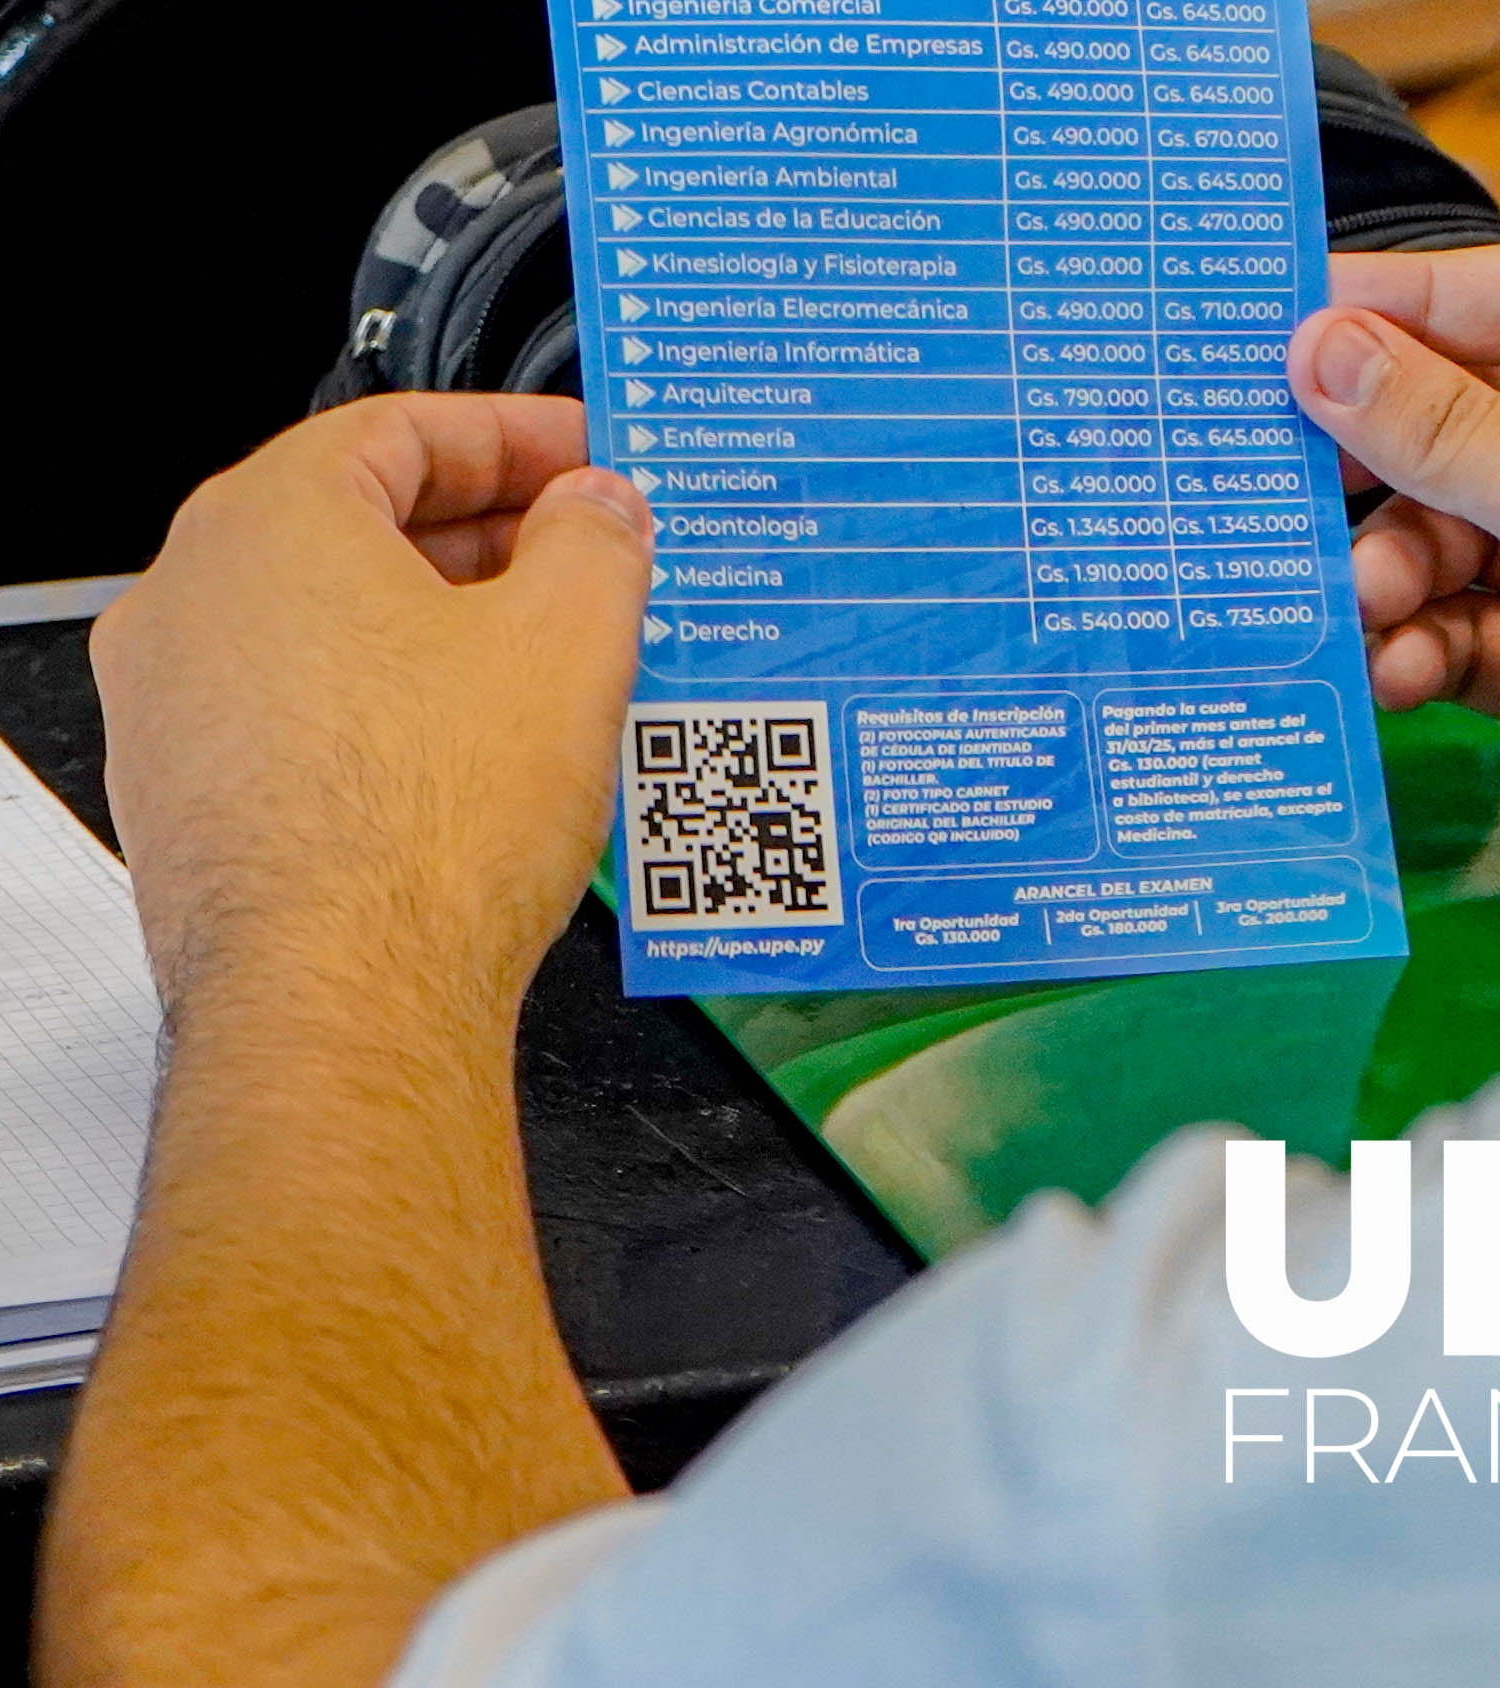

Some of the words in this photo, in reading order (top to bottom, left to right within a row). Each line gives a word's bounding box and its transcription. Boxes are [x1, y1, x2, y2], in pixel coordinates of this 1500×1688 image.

[1146, 1, 1178, 21] Gs.
[1182, 2, 1267, 23] 645.000
[634, 32, 822, 55] Administración
[828, 33, 860, 55] de
[865, 33, 984, 59] Empresas
[1005, 39, 1039, 59] Gs.
[1043, 40, 1131, 61] 490.000
[1149, 43, 1182, 62] Gs.
[1185, 44, 1271, 64] 645.000
[636, 79, 742, 102] Ciencias
[747, 79, 870, 102] Contables
[1008, 81, 1042, 101] Gs.
[1046, 82, 1134, 102] 490.000
[1153, 84, 1185, 103] Gs.
[1189, 84, 1274, 105] 645.000
[641, 120, 766, 147] Ingeniería
[772, 121, 919, 147] Agronómica
[1012, 125, 1047, 146] Gs.
[1051, 126, 1139, 146] 490.000
[1157, 128, 1190, 148] Gs.
[1194, 129, 1279, 149] 670.000
[645, 165, 769, 192] Ingeniería
[775, 166, 898, 189] Ambiental
[1014, 170, 1047, 190] Gs.
[1052, 170, 1142, 190] 490.000
[1160, 171, 1193, 191] Gs.
[1197, 171, 1284, 191] 645.000
[648, 206, 751, 228] Ciencias
[755, 207, 787, 229] de
[793, 207, 813, 229] la
[819, 208, 941, 231] Educación
[1015, 211, 1048, 231] Gs.
[1053, 211, 1143, 231] 490.000
[1159, 212, 1193, 232] Gs.
[1197, 212, 1284, 232] 470.000
[652, 251, 798, 279] Kinesiología
[803, 258, 818, 280] y
[824, 253, 958, 281] Fisioterapia
[1016, 255, 1050, 276] Gs.
[1055, 256, 1143, 276] 490.000
[1162, 255, 1195, 276] Gs.
[1199, 256, 1288, 276] 645.000
[655, 295, 776, 322] Ingeniería
[783, 297, 969, 321] Elecromecánica
[1019, 300, 1052, 320] Gs.
[1056, 301, 1144, 321] 490.000
[1164, 301, 1197, 321] Gs.
[1200, 301, 1283, 321] 710.000
[657, 340, 778, 367] Ingeniería
[785, 340, 921, 363] Informática
[1021, 343, 1055, 363] Gs.
[1059, 343, 1146, 363] 490.000
[1165, 343, 1197, 363] Gs.
[1201, 343, 1289, 363] 645.000
[662, 382, 813, 408] Arquitectura
[1026, 387, 1059, 408] Gs.
[1063, 388, 1150, 407] 790.000
[1166, 388, 1199, 407] Gs.
[1203, 388, 1290, 408] 860.000
[663, 426, 796, 449] Enfermería
[1028, 427, 1061, 448] Gs.
[1065, 428, 1153, 447] 490.000
[1171, 428, 1204, 447] Gs.
[1207, 427, 1295, 447] 645.000
[666, 468, 778, 491] Nutrición
[1031, 474, 1065, 495] Gs.
[1069, 474, 1157, 494] 490.000
[1175, 473, 1208, 493] Gs.
[1212, 472, 1300, 493] 645.000
[670, 514, 819, 542] Odontología
[1030, 517, 1064, 537] Gs.
[1067, 516, 1167, 537] 1.345.000
[1172, 516, 1205, 536] Gs.
[1207, 513, 1309, 535] 1.345.000
[675, 565, 784, 587] Medicina
[1036, 563, 1069, 583] Gs.
[1072, 562, 1169, 583] 1.910.000
[1178, 560, 1212, 582] Gs.
[1214, 557, 1314, 580] 1.910.000
[1043, 612, 1077, 633] Gs.
[1080, 610, 1171, 631] 540.000
[1188, 609, 1224, 629] Gs.
[1225, 604, 1315, 627] 735.000
[678, 619, 781, 643] Derecho
[857, 709, 943, 725] Requisitos
[947, 709, 968, 723] de
[972, 706, 1064, 722] Inscripción
[1102, 705, 1176, 720] Pagando
[1180, 704, 1195, 716] la
[1199, 702, 1246, 714] cuota
[1104, 723, 1129, 737] del
[1134, 723, 1187, 737] primer
[1192, 720, 1226, 733] mes
[1230, 717, 1275, 731] antes
[1280, 715, 1305, 728] del
[1180, 736, 1215, 751] más
[1220, 736, 1234, 749] el
[1237, 732, 1299, 748] arancel
[1304, 732, 1324, 744] de
[1108, 758, 1133, 772] Gs.
[1138, 755, 1197, 770] 130.000
[1202, 753, 1262, 769] (carnet
[1111, 771, 1199, 789] estudiantil
[1203, 773, 1213, 786] y
[1217, 768, 1284, 784] derecho
[1113, 795, 1124, 807] a
[1128, 789, 1220, 807] biblioteca),
[1223, 791, 1242, 803] se
[1247, 787, 1312, 801] exonera
[1317, 783, 1332, 797] el
[867, 817, 930, 830] ORIGINAL
[933, 816, 959, 828] DEL
[962, 814, 1036, 826] BACHILLER
[1115, 812, 1159, 826] costo
[1164, 809, 1185, 824] de
[1278, 800, 1343, 817] excepto
[1118, 828, 1196, 844] Medicina.
[1014, 884, 1096, 902] ARANCEL
[1101, 881, 1136, 896] DEL
[1140, 878, 1214, 894] EXAMEN
[1216, 900, 1244, 914] 3ra
[1246, 892, 1345, 913] Oportunidad
[895, 917, 917, 933] 1ra
[920, 913, 1020, 931] Oportunidad
[1056, 910, 1087, 924] 2da
[1090, 904, 1189, 923] Oportunidad
[1238, 911, 1263, 926] Gs.
[1267, 908, 1328, 924] 200.000
[915, 931, 939, 945] Gs.
[943, 929, 1001, 943] 130.000
[1080, 923, 1105, 937] Gs.
[1109, 919, 1167, 934] 180.000
[648, 937, 825, 960] https://upe.upe.py
